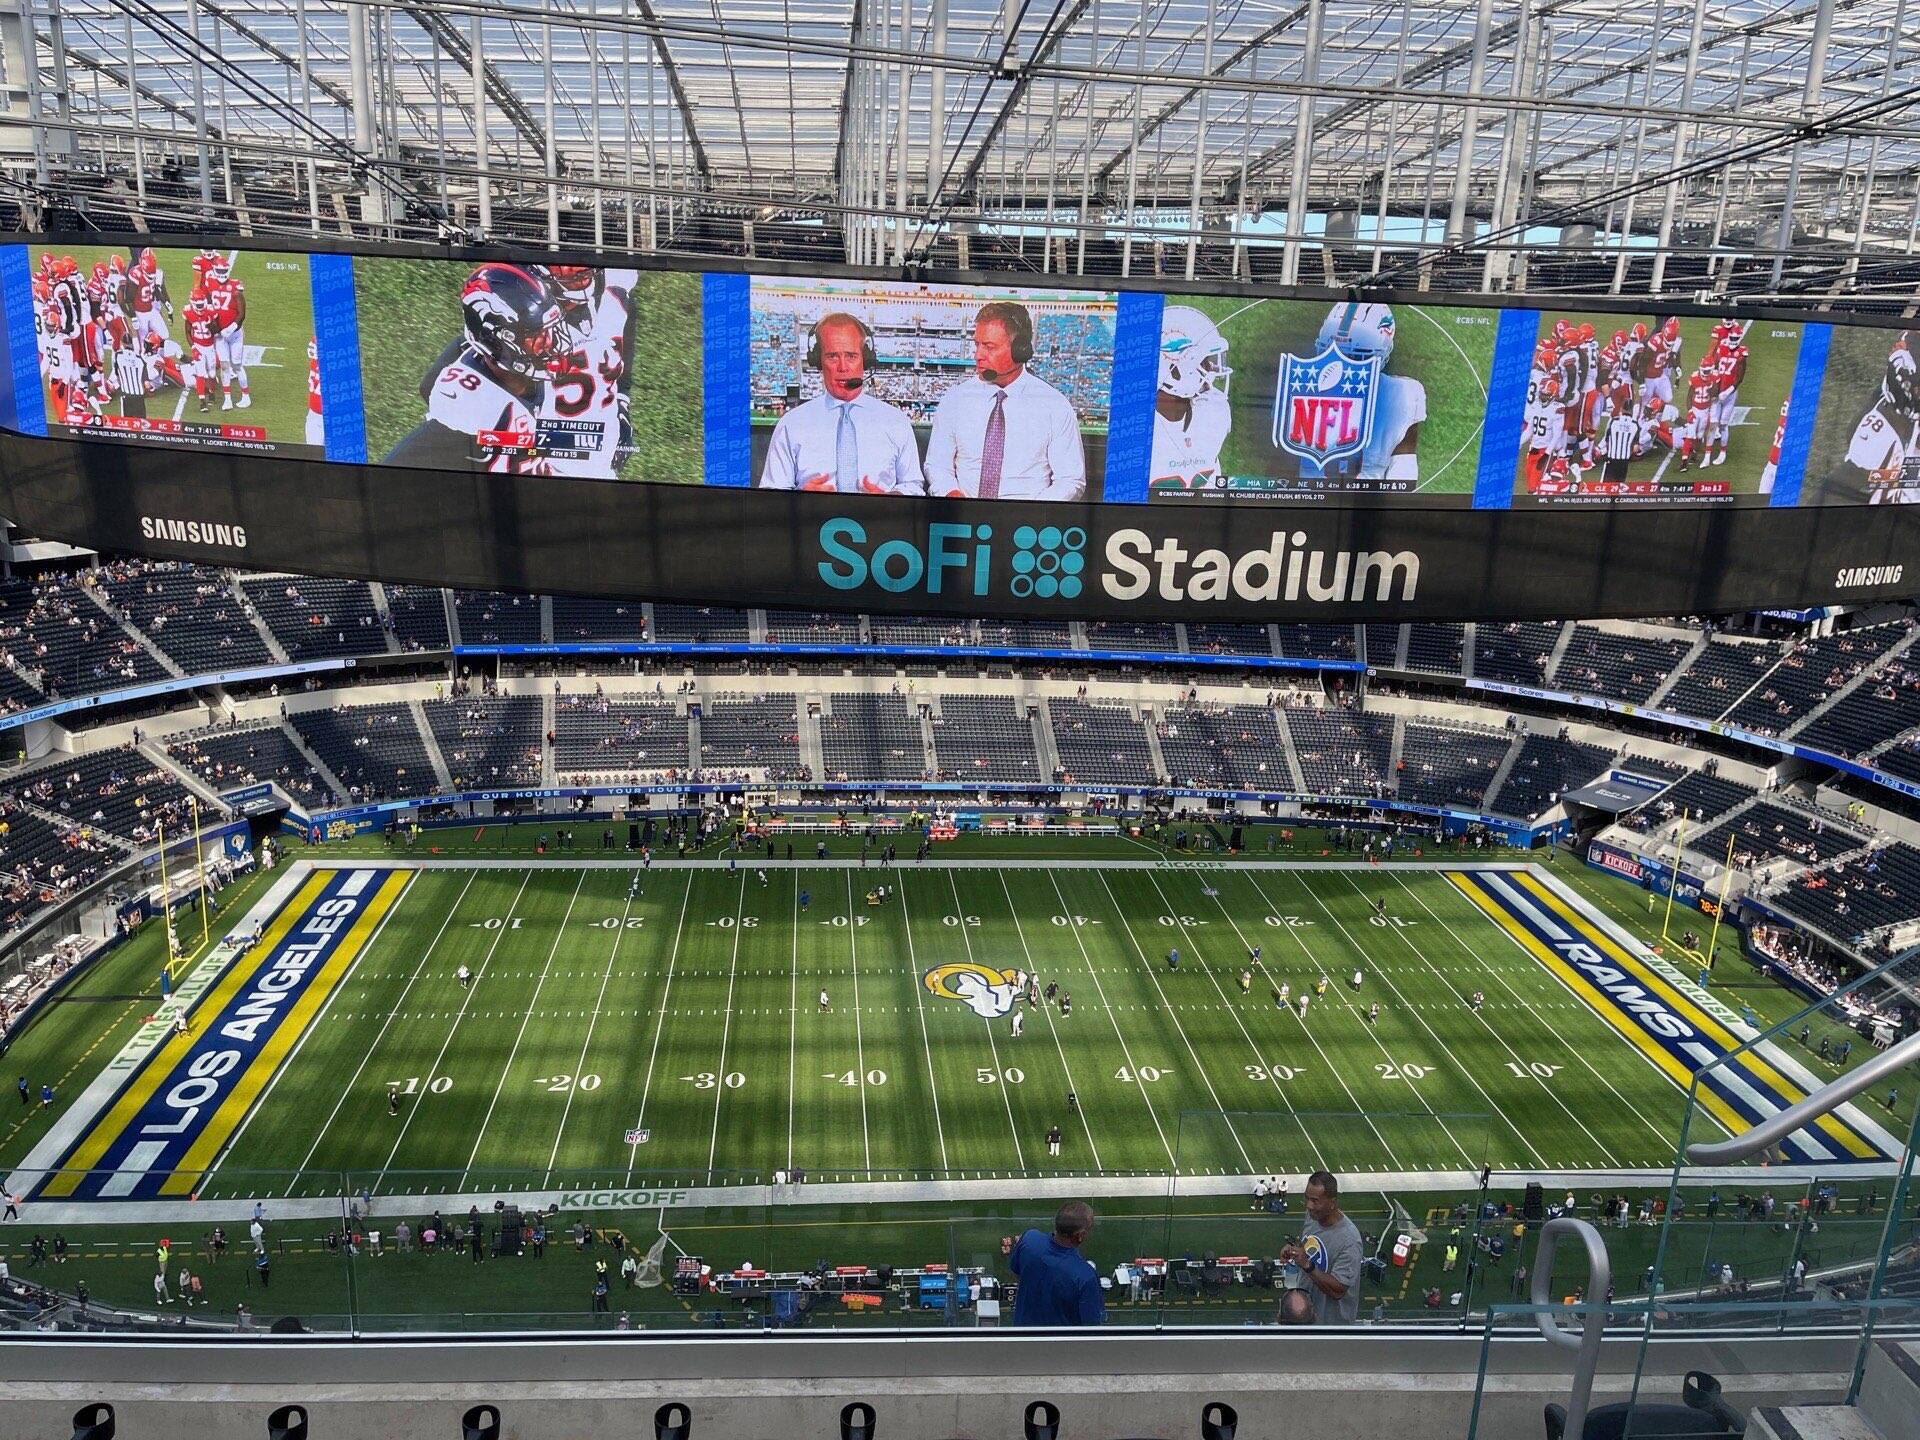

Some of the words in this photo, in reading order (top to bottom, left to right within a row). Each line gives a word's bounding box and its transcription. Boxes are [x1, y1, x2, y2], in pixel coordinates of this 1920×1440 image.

[270, 262, 284, 270] CBS
[288, 264, 301, 272] NFL
[211, 290, 232, 310] 67
[1460, 316, 1474, 324] CBS
[1478, 317, 1490, 325] NFL
[441, 367, 482, 392] 58
[173, 424, 182, 432] 27
[230, 428, 244, 436] 3RD
[541, 420, 558, 429] 2ND
[560, 422, 600, 430] TIMEOUT
[1290, 398, 1359, 451] NFL
[1861, 414, 1884, 433] 58
[517, 434, 530, 445] 27
[538, 434, 545, 446] 7
[501, 447, 517, 455] 3:01
[551, 450, 564, 458] 4TH
[1267, 480, 1275, 488] 17
[141, 516, 248, 548] SAMSUNG
[818, 517, 992, 595] SoFi
[1102, 529, 1419, 602] Stadium
[1835, 565, 1903, 588] SAMSUNG
[1483, 682, 1504, 691] Week
[1518, 688, 1544, 698] Scores
[0, 720, 15, 728] eek
[30, 708, 57, 720] Leaders
[1646, 712, 1663, 720] FINAL
[1765, 740, 1781, 750] FINAL
[482, 792, 509, 800] OUR
[516, 790, 561, 798] HOUSE
[608, 786, 641, 794] YOUR
[648, 786, 691, 794] HOUSE
[1326, 798, 1367, 806] HOUSE
[1604, 852, 1639, 876] KICKOFF
[1700, 898, 1720, 917] 78:2
[484, 918, 526, 930] 10
[602, 917, 645, 929] 20
[718, 916, 760, 928] 30
[832, 915, 871, 927] 40
[942, 915, 982, 927] 50
[1050, 915, 1088, 926] 40
[1158, 915, 1198, 926] 30
[1264, 916, 1304, 927] 20
[1370, 916, 1408, 927] 10
[1554, 943, 1694, 1038] RAMS
[1640, 954, 1678, 978] END
[1676, 978, 1741, 1025] RACISM
[140, 1050, 242, 1134] LOS
[221, 899, 358, 1042] ANGELES
[110, 1056, 138, 1070] IT
[130, 1006, 176, 1050] TAKES
[838, 1070, 887, 1086] 40
[976, 1067, 1024, 1084] 50
[1114, 1066, 1160, 1082] 40
[1244, 1064, 1294, 1081] 30
[1374, 1063, 1424, 1080] 20
[1504, 1062, 1554, 1078] 10
[400, 1076, 454, 1095] 10
[548, 1074, 602, 1092] 20
[694, 1072, 746, 1089] 30
[560, 1192, 686, 1207] KICKOFF
